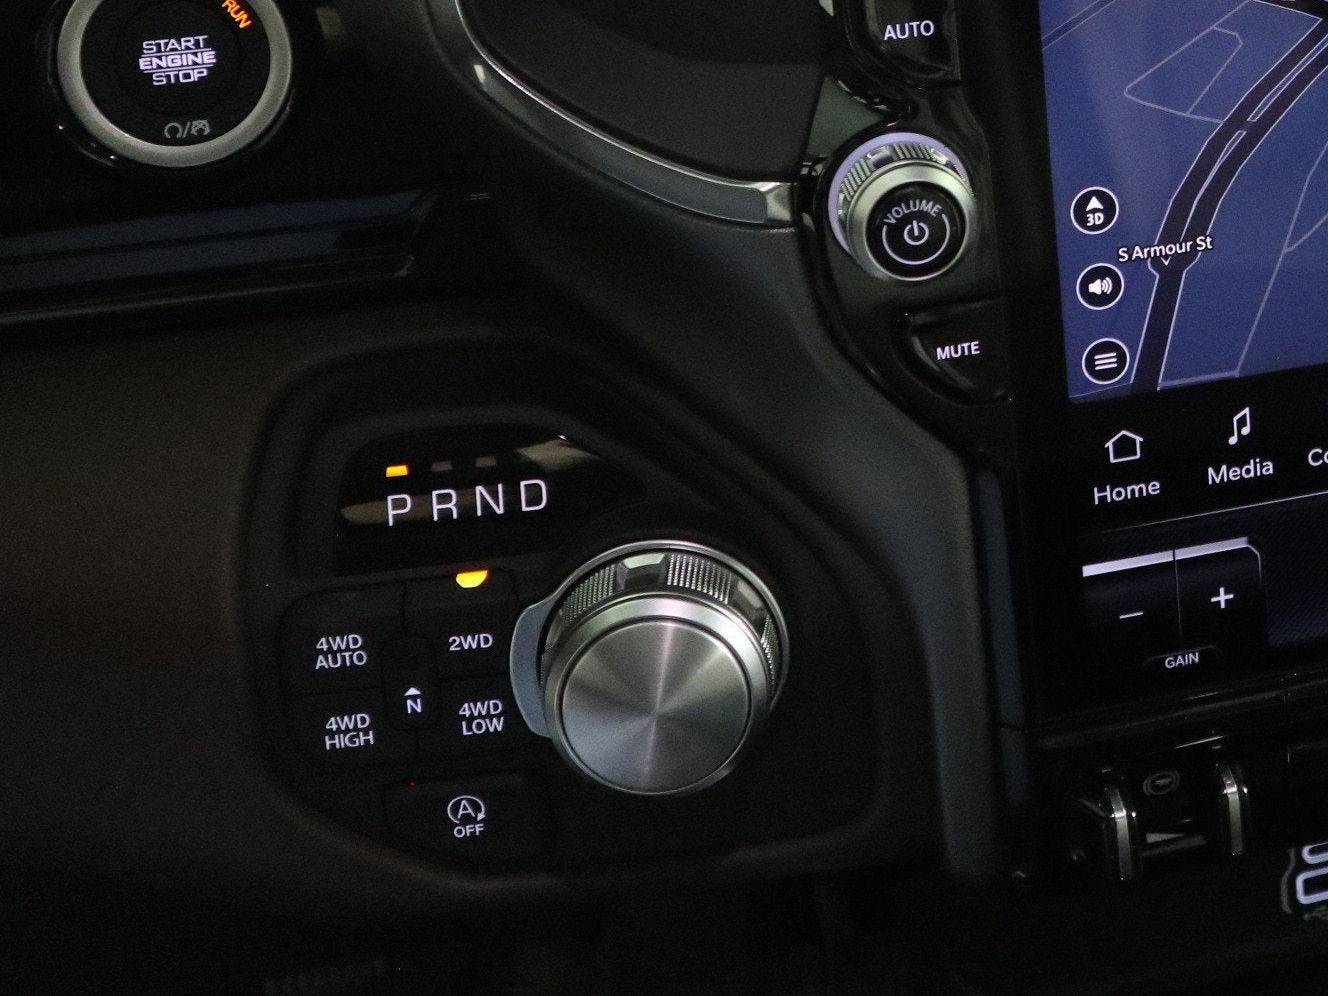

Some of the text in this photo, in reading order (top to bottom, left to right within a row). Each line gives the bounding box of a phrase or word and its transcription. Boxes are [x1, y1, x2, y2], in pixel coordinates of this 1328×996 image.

[884, 20, 935, 41] AUTO
[142, 35, 209, 54] START
[138, 51, 216, 70] ENGINE
[152, 68, 208, 86] STOP
[884, 199, 943, 225] VOLUME
[1087, 212, 1105, 227] 3D
[1118, 236, 1213, 262] S Armour St
[936, 340, 981, 362] MUTE
[1207, 459, 1275, 485] Media
[1093, 480, 1162, 505] Home
[316, 634, 362, 652] 4WD
[448, 633, 493, 651] 2WD
[315, 651, 367, 670] AUTO
[1165, 652, 1199, 669] GAIN
[406, 698, 422, 714] N
[459, 699, 503, 717] 4WD
[325, 714, 371, 732] 4WD
[461, 717, 504, 736] LOW
[324, 731, 374, 751] HIGH
[453, 824, 484, 838] OFF
